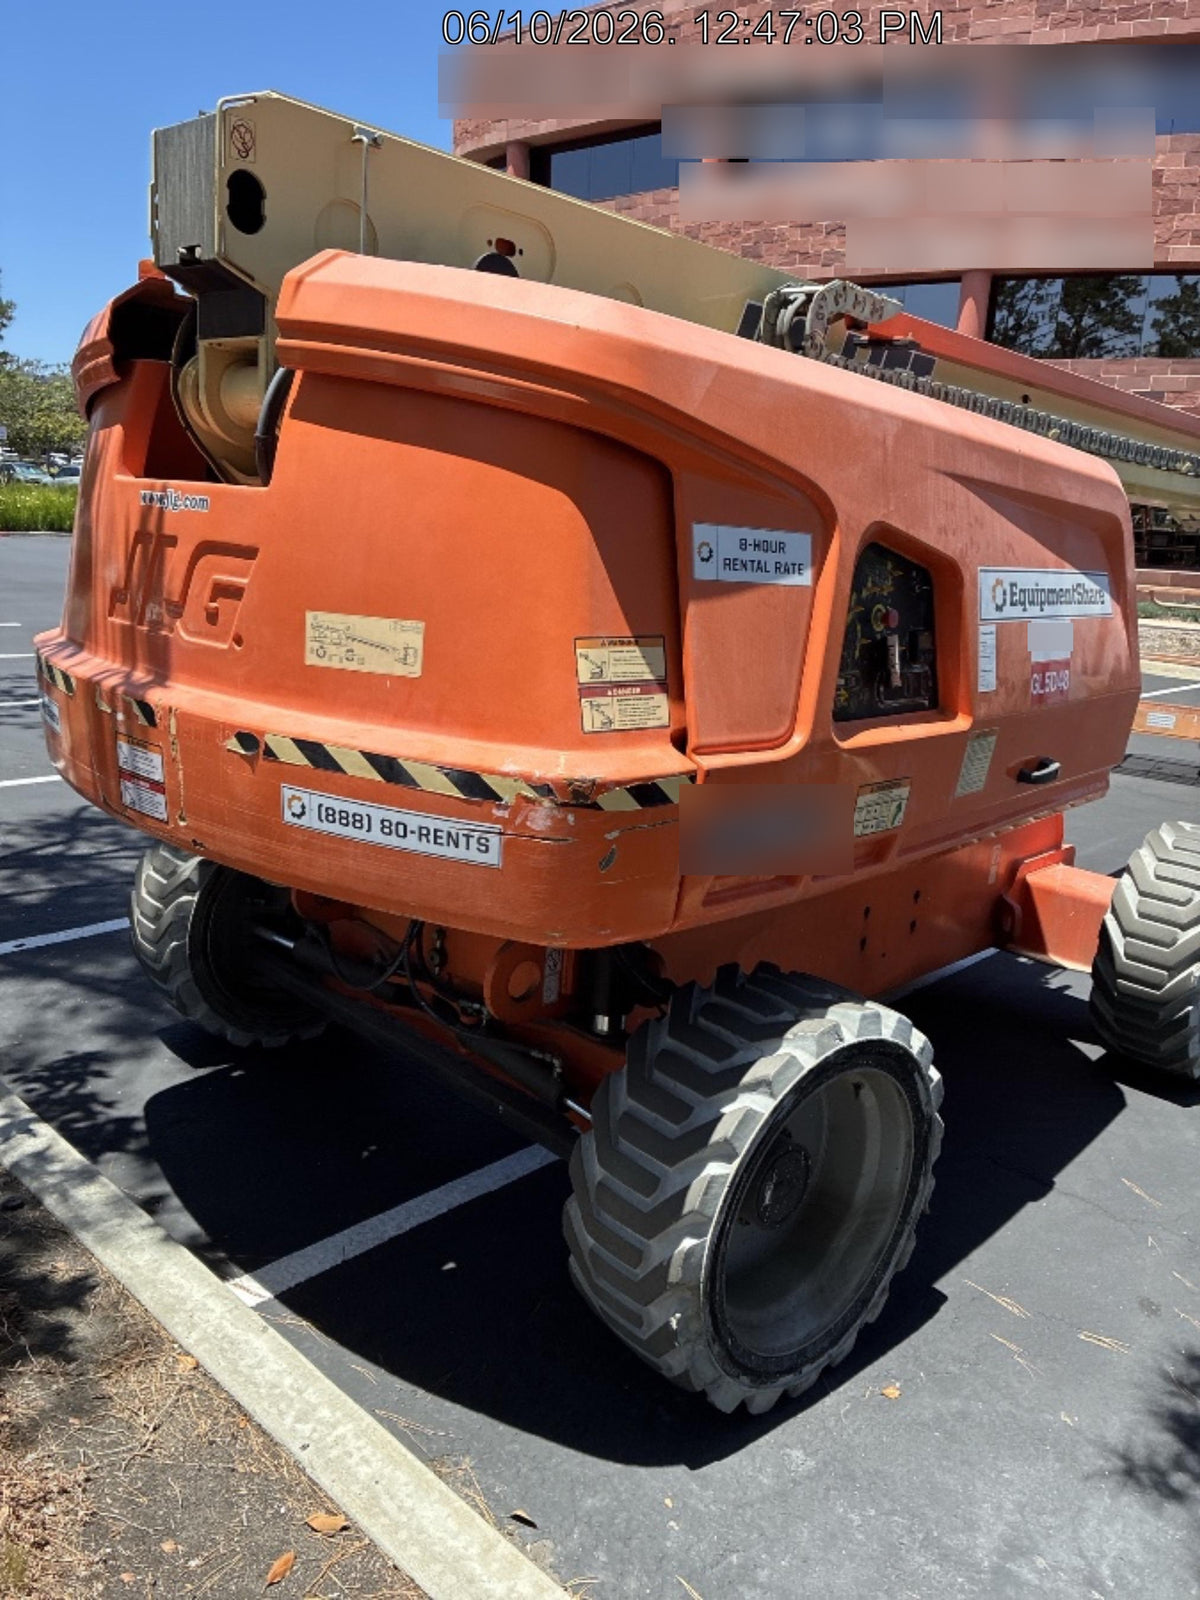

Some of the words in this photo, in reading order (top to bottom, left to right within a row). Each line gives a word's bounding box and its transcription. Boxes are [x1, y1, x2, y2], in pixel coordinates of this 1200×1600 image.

[739, 538, 786, 554] 8-HOUR
[723, 557, 770, 573] RENTAL
[775, 561, 804, 575] RATE
[107, 530, 259, 650] JLG
[1009, 582, 1105, 612] EquipmentShare
[317, 803, 372, 833] (888)
[379, 818, 490, 854] 80-RENTS
